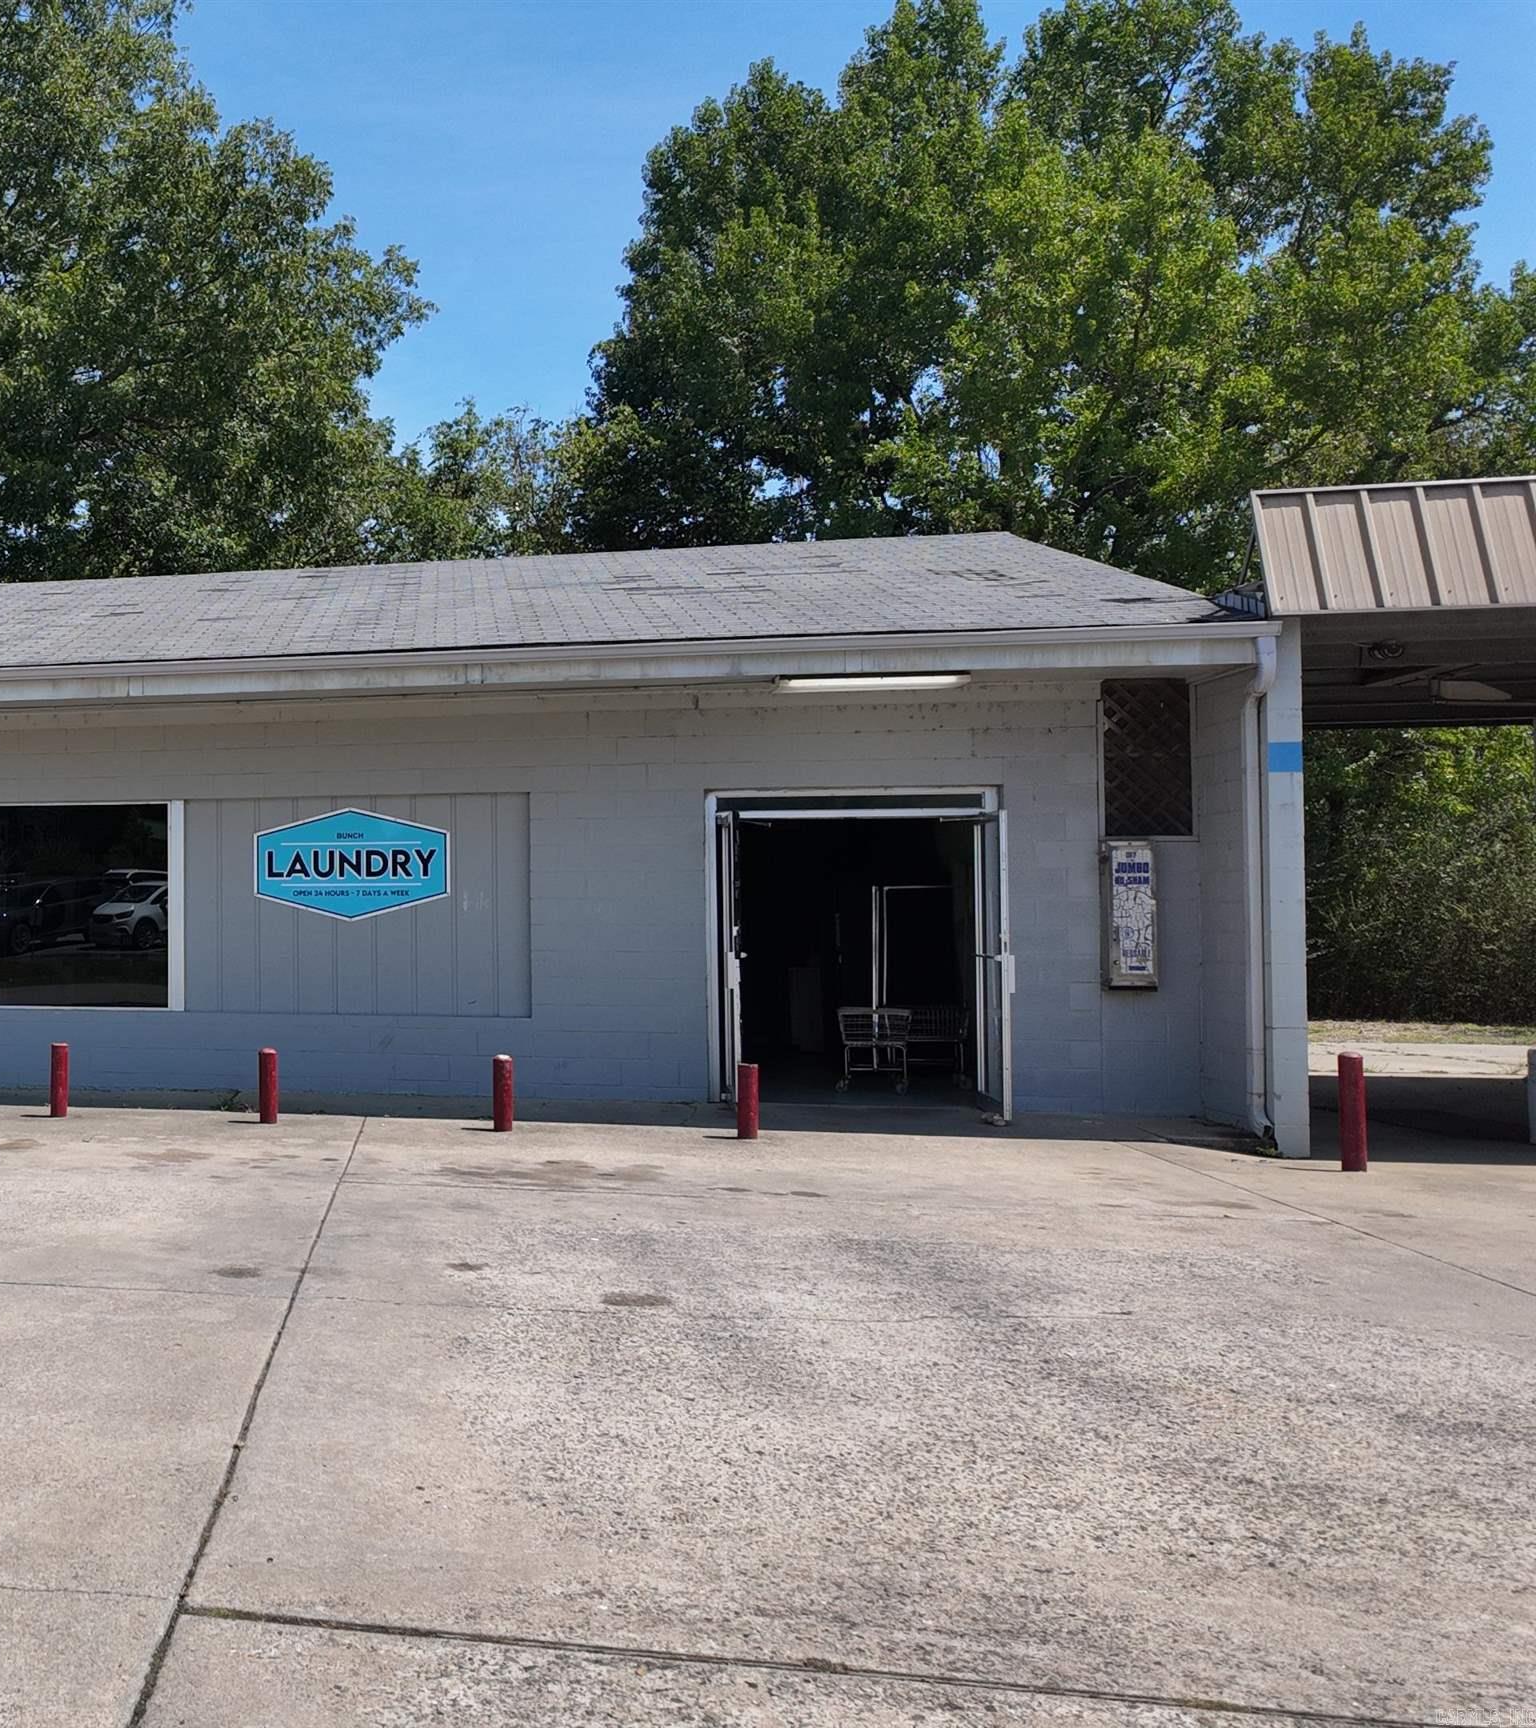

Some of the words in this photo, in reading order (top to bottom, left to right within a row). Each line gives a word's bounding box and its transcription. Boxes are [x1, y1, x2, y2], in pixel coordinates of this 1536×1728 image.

[336, 831, 365, 840] BUNCH
[266, 848, 437, 879] LAUNDRY
[1114, 862, 1150, 874] JUMBO
[292, 889, 313, 897] OPEN
[325, 889, 350, 897] HOURS
[356, 889, 361, 897] 7
[362, 889, 382, 897] DAYS
[383, 889, 389, 897] A
[390, 889, 410, 897] WEEK
